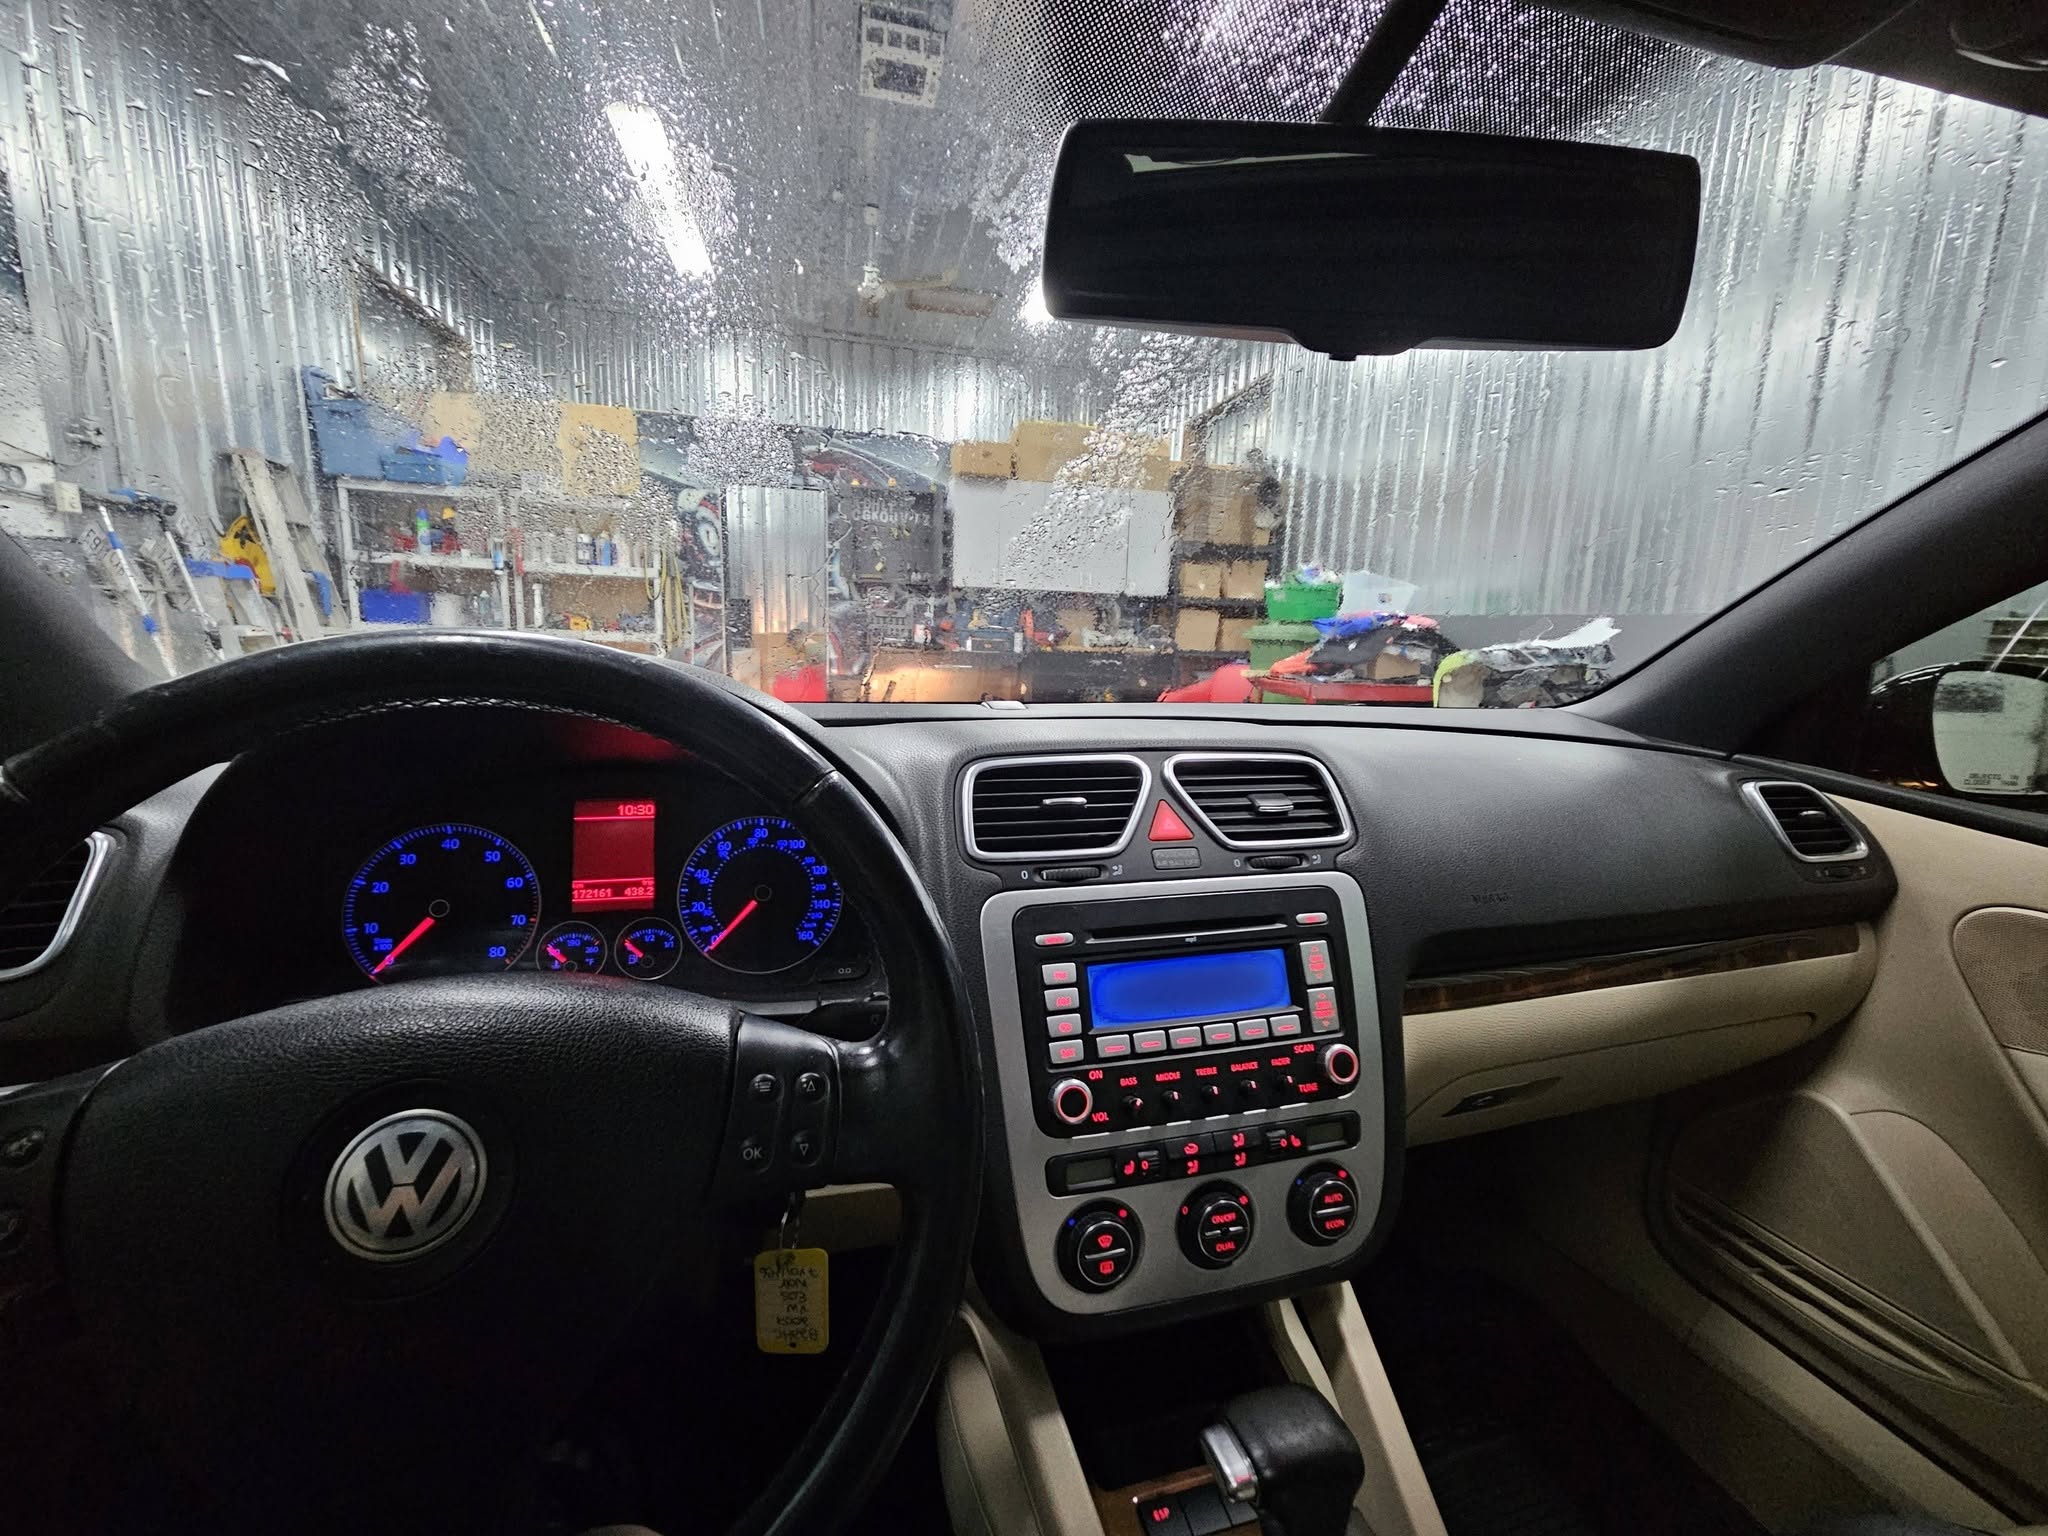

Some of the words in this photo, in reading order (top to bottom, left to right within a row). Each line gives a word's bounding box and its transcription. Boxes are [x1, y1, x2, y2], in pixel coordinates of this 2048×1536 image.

[618, 805, 654, 816] 10:30
[753, 828, 768, 839] 80
[442, 839, 459, 848] 40
[717, 842, 731, 852] 60
[788, 840, 805, 848] 100
[400, 854, 416, 864] 30
[486, 851, 500, 862] 50
[1234, 859, 1240, 867] 0
[695, 870, 709, 878] 40
[812, 866, 827, 874] 120
[1021, 871, 1028, 879] 0
[373, 882, 388, 893] 20
[507, 878, 523, 888] 60
[572, 889, 613, 899] 172161
[624, 887, 655, 897] 438.2
[692, 902, 705, 912] 20
[814, 900, 830, 908] 140
[512, 915, 526, 925] 70
[365, 923, 378, 933] 10
[799, 931, 813, 940] 160
[489, 947, 505, 957] 80
[1294, 1044, 1314, 1053] SCAN
[1271, 1057, 1290, 1065] FADER
[1196, 1067, 1217, 1075] TREBLE
[1231, 1062, 1258, 1071] BALANCE
[1089, 1070, 1102, 1080] ON
[1156, 1072, 1180, 1081] MIDDLE
[1120, 1077, 1137, 1086] BASS
[1299, 1083, 1318, 1092] TUNE
[1092, 1112, 1109, 1122] VOL
[743, 1148, 761, 1160] OK
[1324, 1193, 1342, 1203] AUTO
[1211, 1213, 1236, 1223] ON/OFF
[1325, 1219, 1344, 1228] ECON
[1216, 1242, 1235, 1251] DUAL
